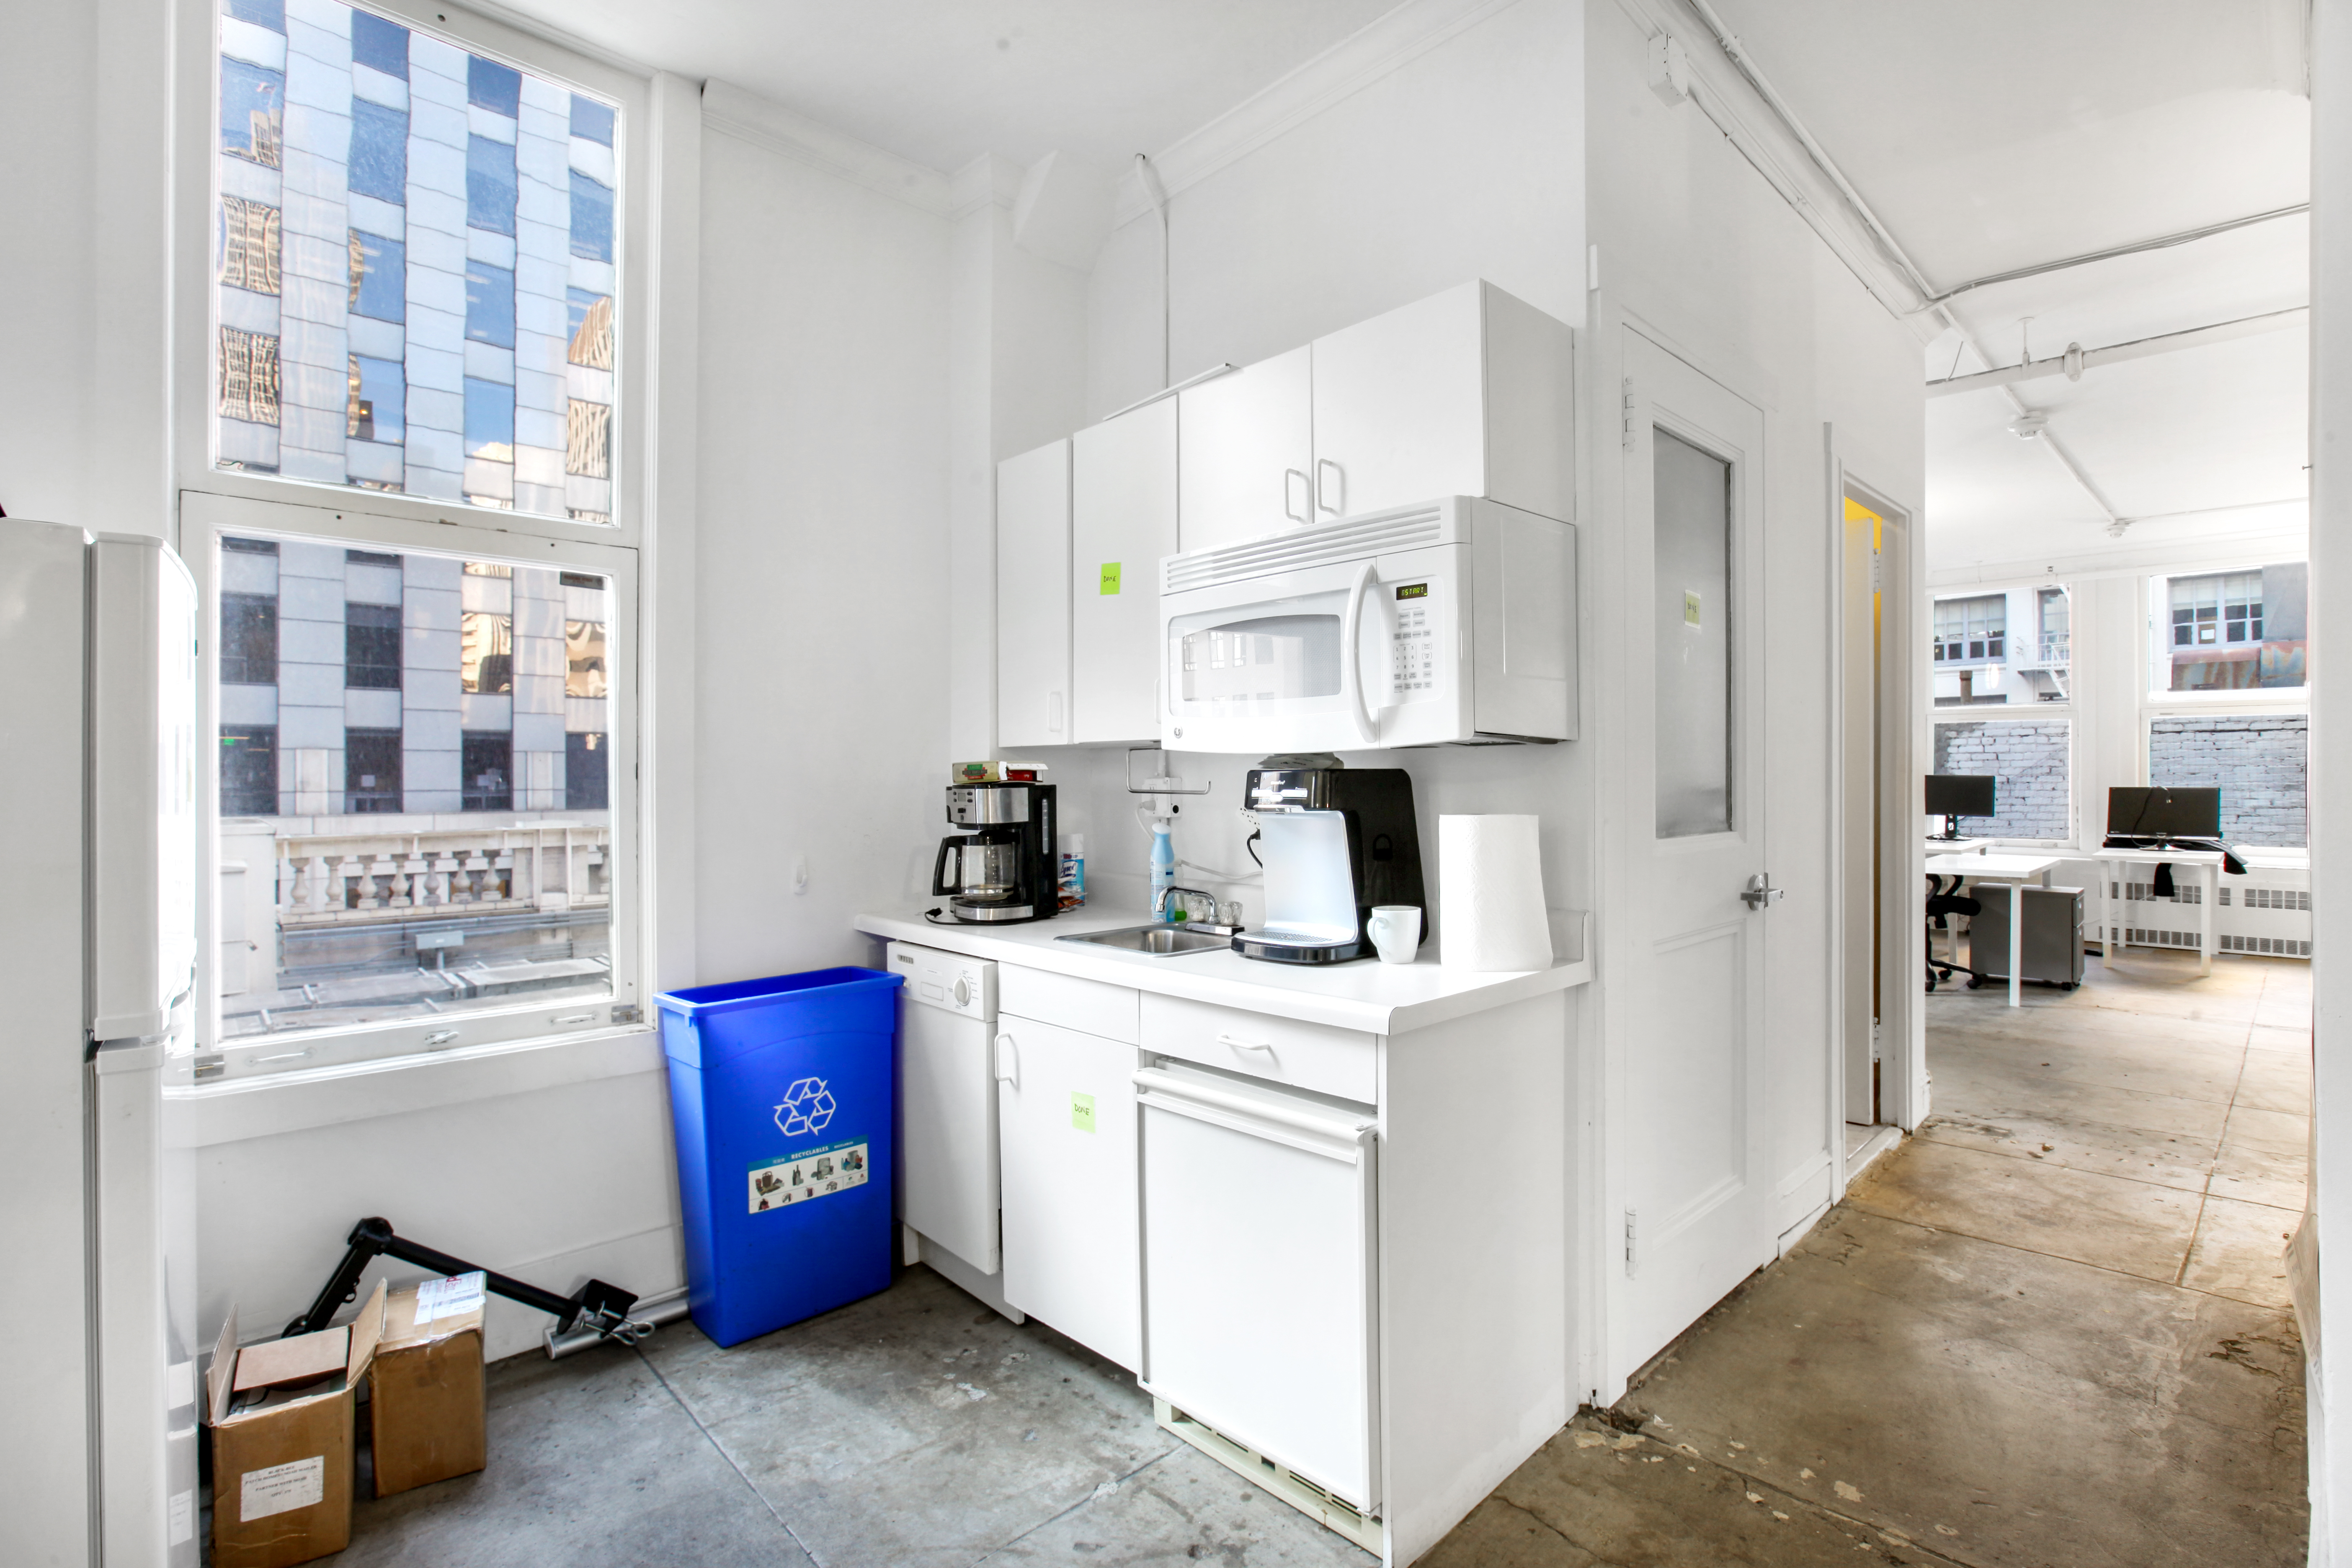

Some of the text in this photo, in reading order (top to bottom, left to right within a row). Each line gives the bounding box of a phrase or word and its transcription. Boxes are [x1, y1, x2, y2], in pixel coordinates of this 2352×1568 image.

[1060, 862, 1076, 875] Lysol
[1074, 1103, 1090, 1116] DONE
[791, 1145, 829, 1160] RECYCLABLES
[445, 1276, 462, 1292] dEx
